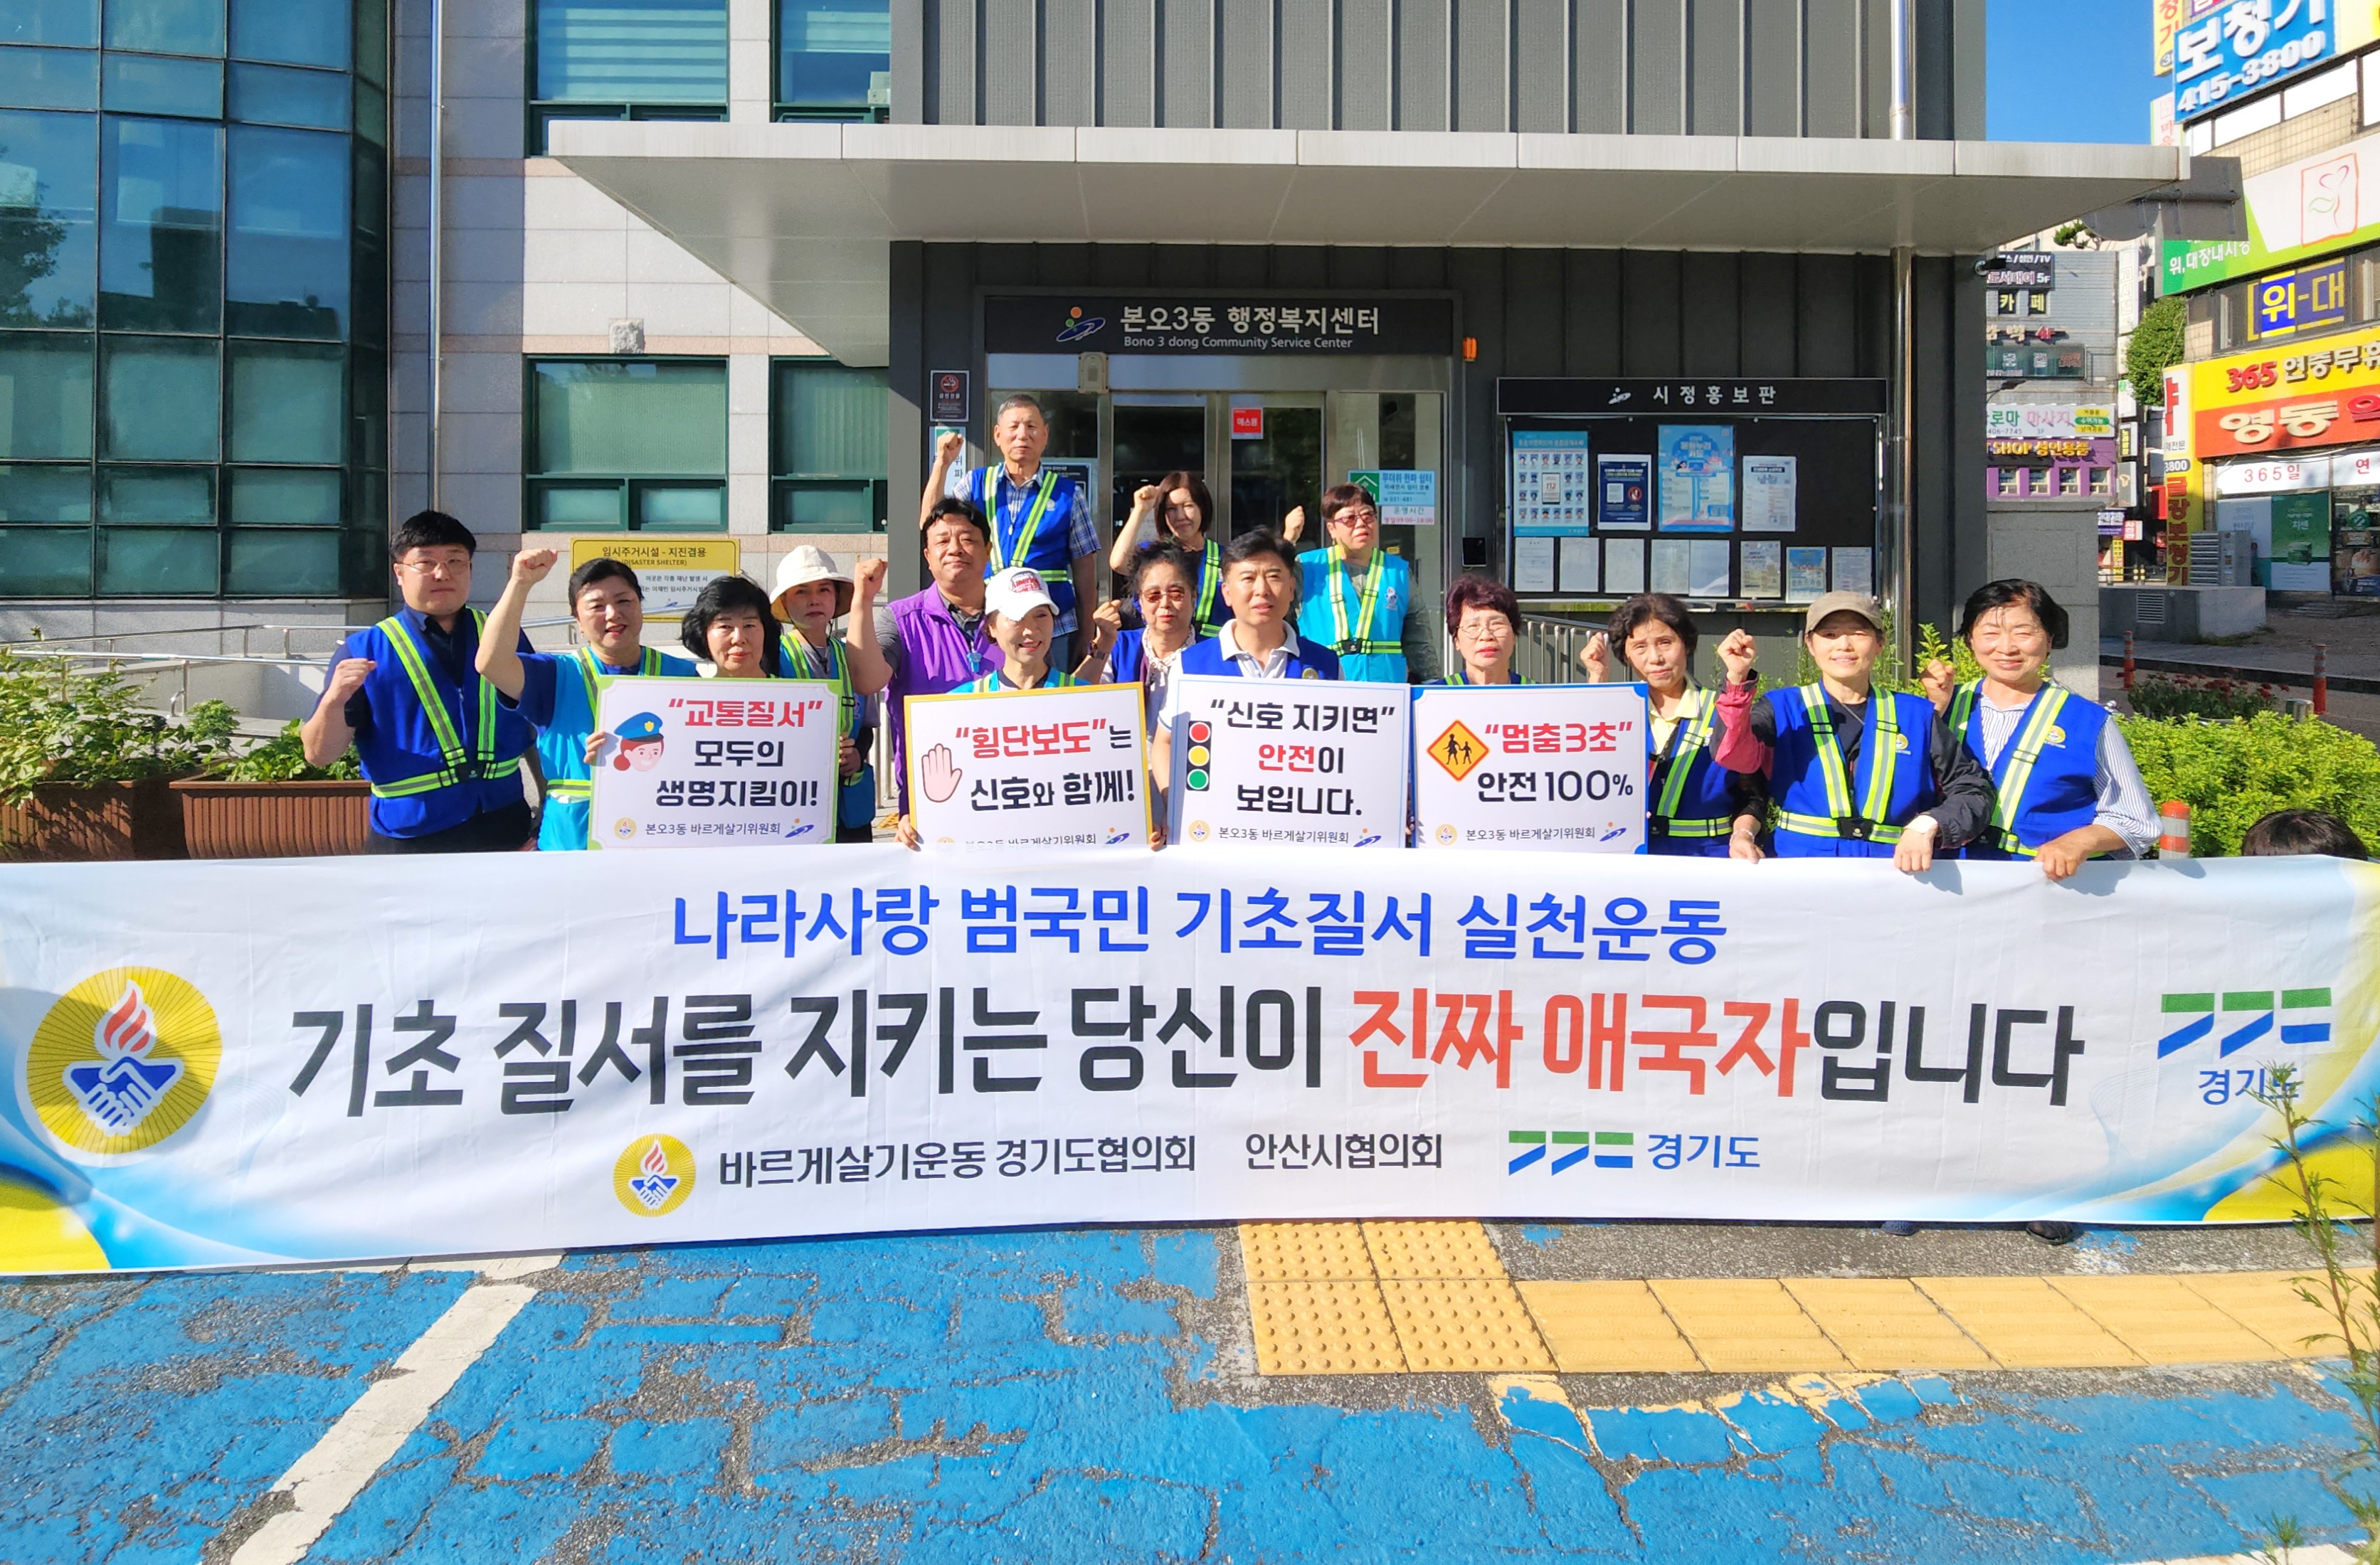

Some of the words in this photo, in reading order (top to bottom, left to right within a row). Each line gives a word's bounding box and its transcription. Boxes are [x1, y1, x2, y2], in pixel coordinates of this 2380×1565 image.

[2177, 0, 2326, 83] 보청기
[2177, 31, 2326, 112] 415-3800
[2036, 272, 2051, 283] 5F
[1120, 306, 1216, 334] 본오3동
[1227, 306, 1379, 335] 행정복지센터
[1124, 336, 1154, 347] Bono
[1157, 337, 1165, 347] 3
[1168, 336, 1199, 349] dong
[1202, 336, 1268, 349] Community
[1271, 337, 1311, 347] Service
[1314, 337, 1353, 348] Center
[2226, 361, 2278, 393] 365
[1653, 386, 1776, 405] 시정홍보판
[1987, 410, 2020, 427] 로마
[2026, 410, 2071, 428] 마사지
[1992, 441, 2032, 455] SHOP
[2034, 440, 2090, 457] 성인용품
[1419, 473, 1432, 484] 쉼터
[2244, 464, 2300, 482] 365일
[602, 546, 660, 558] 임시주거시설
[668, 547, 707, 558] 지진겸용
[694, 740, 784, 767] 모두의
[1258, 744, 1344, 774] 안전이
[656, 780, 818, 807] 생명지킴이!
[970, 776, 1054, 811] 신호와
[1063, 769, 1135, 805] 함께!
[1237, 784, 1363, 816] 보입니다.
[645, 823, 687, 835] 본오3동
[691, 822, 781, 835] 바르게살기위원회
[1218, 827, 1259, 840] 본오3동
[1262, 829, 1349, 844] 바르게살기위원회
[1466, 829, 1506, 841] 본오3동
[1509, 827, 1595, 840] 바르게살기위원회
[675, 885, 940, 960] 나라사랑
[961, 885, 1150, 953] 범국민
[1175, 886, 1431, 957] 기초질서
[1456, 892, 1728, 965] 실천운동
[288, 999, 464, 1118] 기초
[493, 994, 763, 1115] 질서를
[784, 987, 1048, 1098] 지키는
[1071, 985, 1322, 1093] 당신이
[1348, 987, 1524, 1090] 진짜
[1543, 992, 2086, 1107] 애국자입니다
[719, 1140, 987, 1189] 바르게살기운동
[995, 1135, 1196, 1179] 경기도협의회
[1245, 1133, 1443, 1170] 안산시협의회
[1647, 1133, 1761, 1170] 경기도
